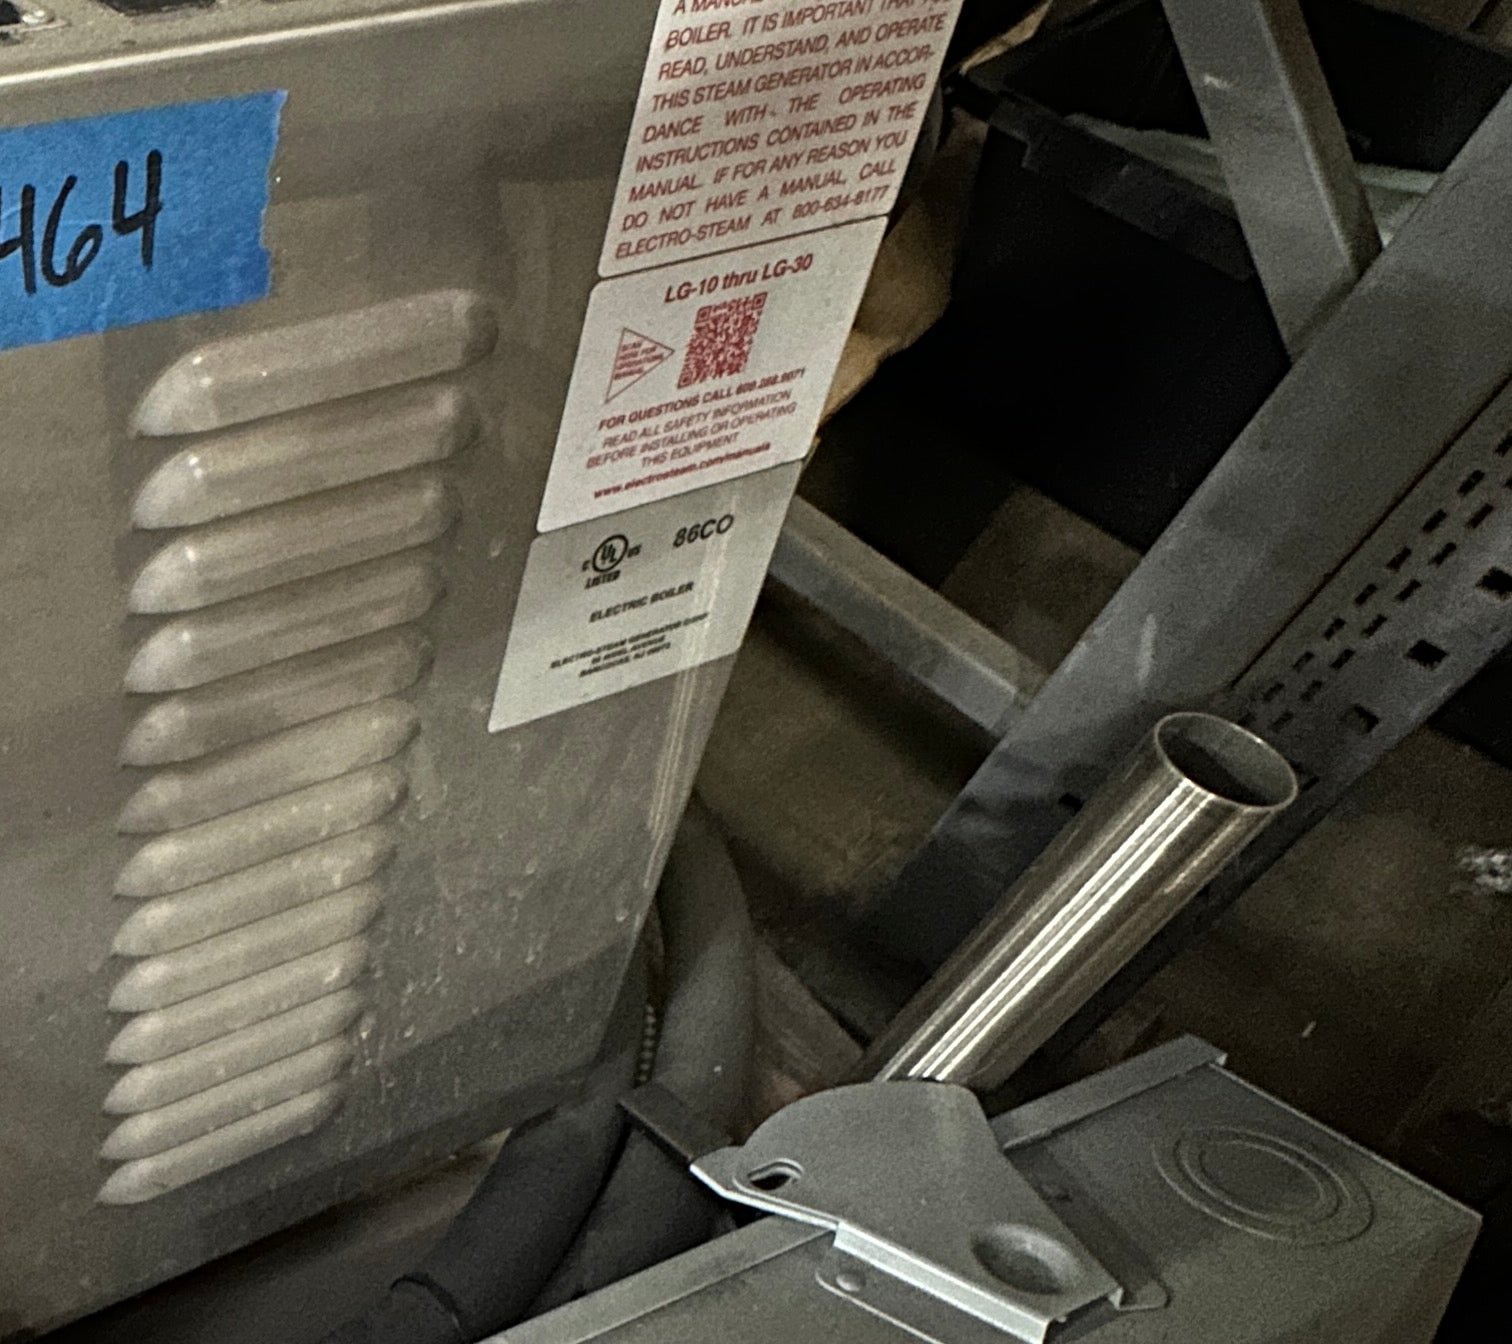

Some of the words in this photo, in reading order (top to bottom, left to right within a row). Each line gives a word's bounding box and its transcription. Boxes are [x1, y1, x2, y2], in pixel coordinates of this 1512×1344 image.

[658, 56, 708, 80] READ,
[716, 34, 830, 70] UNDERSTAND,
[835, 26, 872, 48] AND
[875, 12, 947, 42] OPERATE
[742, 15, 761, 35] IT
[762, 12, 779, 32] IS
[652, 88, 691, 112] THIS
[692, 78, 752, 105] STEAM
[754, 58, 852, 93] GENERATOR
[854, 55, 873, 73] IN
[872, 44, 934, 70] ACCOR-
[642, 115, 704, 144] DANCE
[725, 104, 768, 126] WITH
[788, 93, 820, 114] THE
[838, 72, 926, 104] OPERATING
[636, 132, 760, 172] INSTRUCTIONS
[766, 114, 857, 147] CONTAINED
[862, 110, 880, 126] IN
[888, 101, 918, 121] THE
[713, 166, 730, 184] IF
[732, 158, 768, 180] FOR
[769, 152, 804, 172] ANY
[806, 139, 871, 164] REASON
[876, 130, 908, 149] YOU
[622, 211, 648, 232] DO
[659, 200, 696, 222] NOT
[705, 189, 748, 212] HAVE
[757, 185, 769, 201] A
[859, 158, 896, 180] CALL
[615, 214, 752, 260] ELECTRO-STEAM
[761, 207, 783, 226] AT
[664, 275, 719, 304] LG-10
[722, 266, 758, 290] thru
[761, 253, 814, 281] LG-30
[598, 415, 626, 430] FOR
[628, 395, 699, 423] QUESTIONS
[702, 388, 732, 404] CALL
[603, 430, 637, 447] READ
[639, 426, 659, 438] ALL
[664, 411, 710, 432] SAFETY
[672, 514, 734, 548] 86CO
[590, 596, 648, 622] ELECTRIC
[650, 582, 694, 603] BOILER
